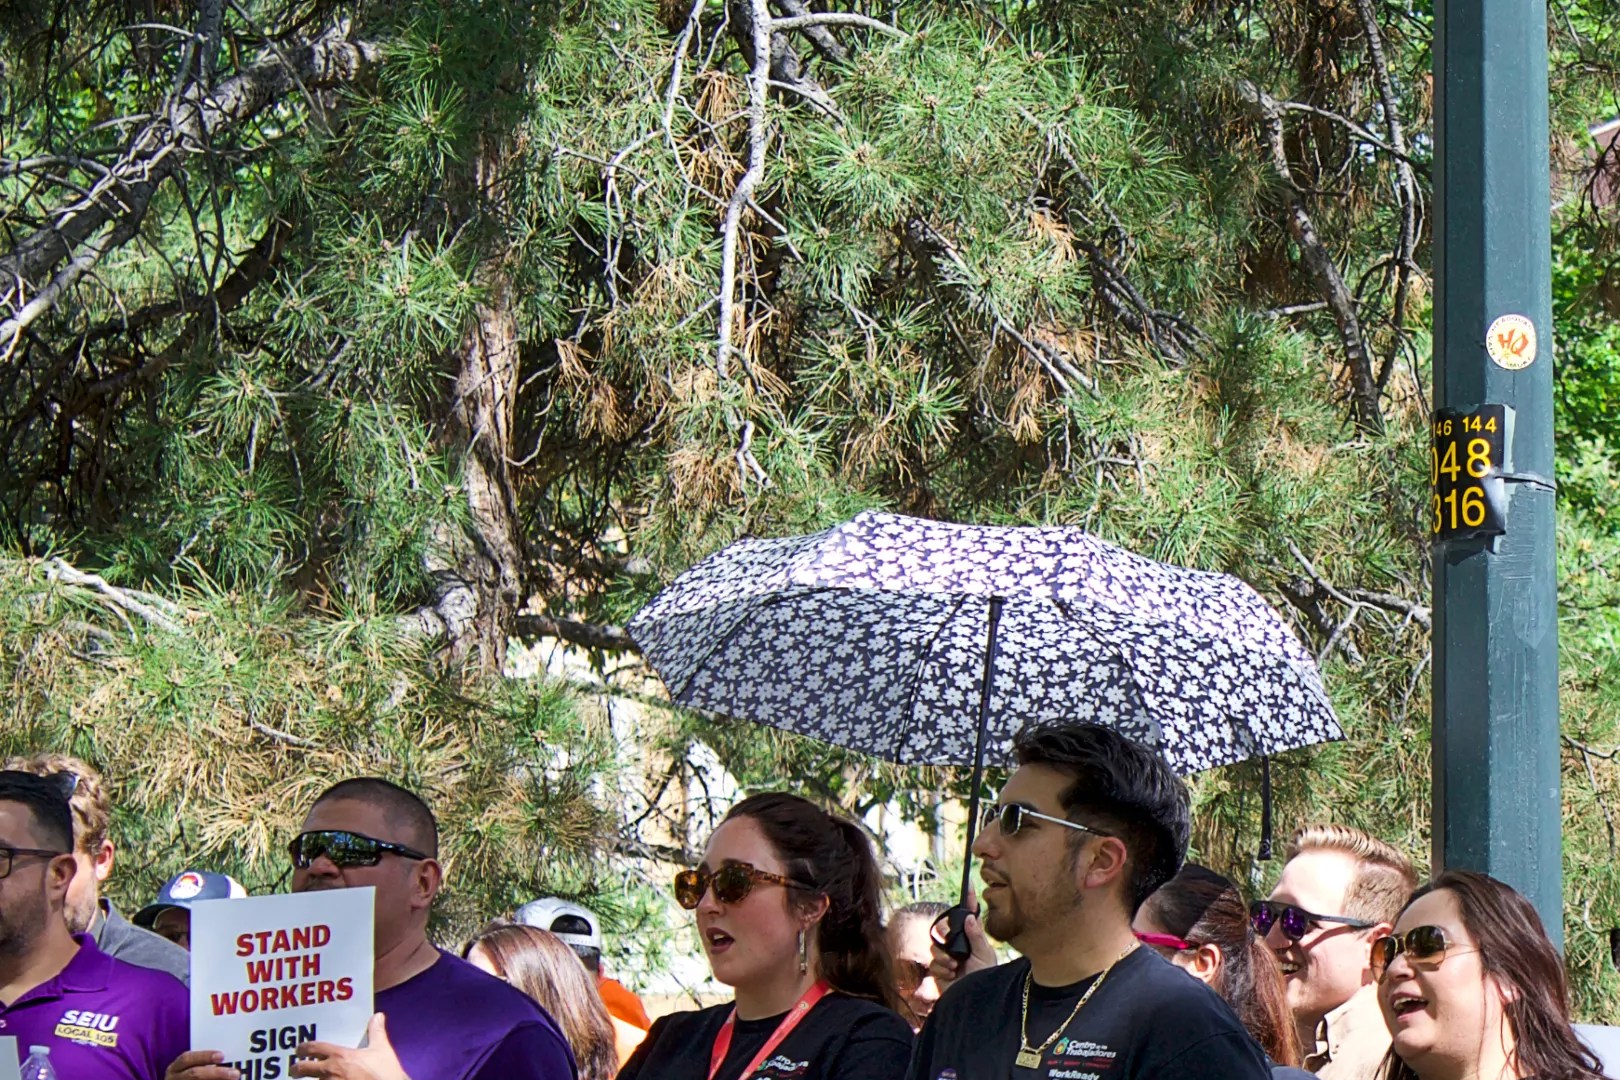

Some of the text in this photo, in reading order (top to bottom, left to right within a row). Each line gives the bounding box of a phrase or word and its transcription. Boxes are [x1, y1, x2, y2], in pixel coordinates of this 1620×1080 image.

[1462, 415, 1497, 433] 144
[236, 924, 331, 957] STAND
[246, 953, 321, 984] WITH
[210, 977, 354, 1016] WORKERS
[57, 1026, 93, 1038] LOCAL
[60, 1009, 119, 1032] SEIU
[249, 1023, 317, 1053] SIGN
